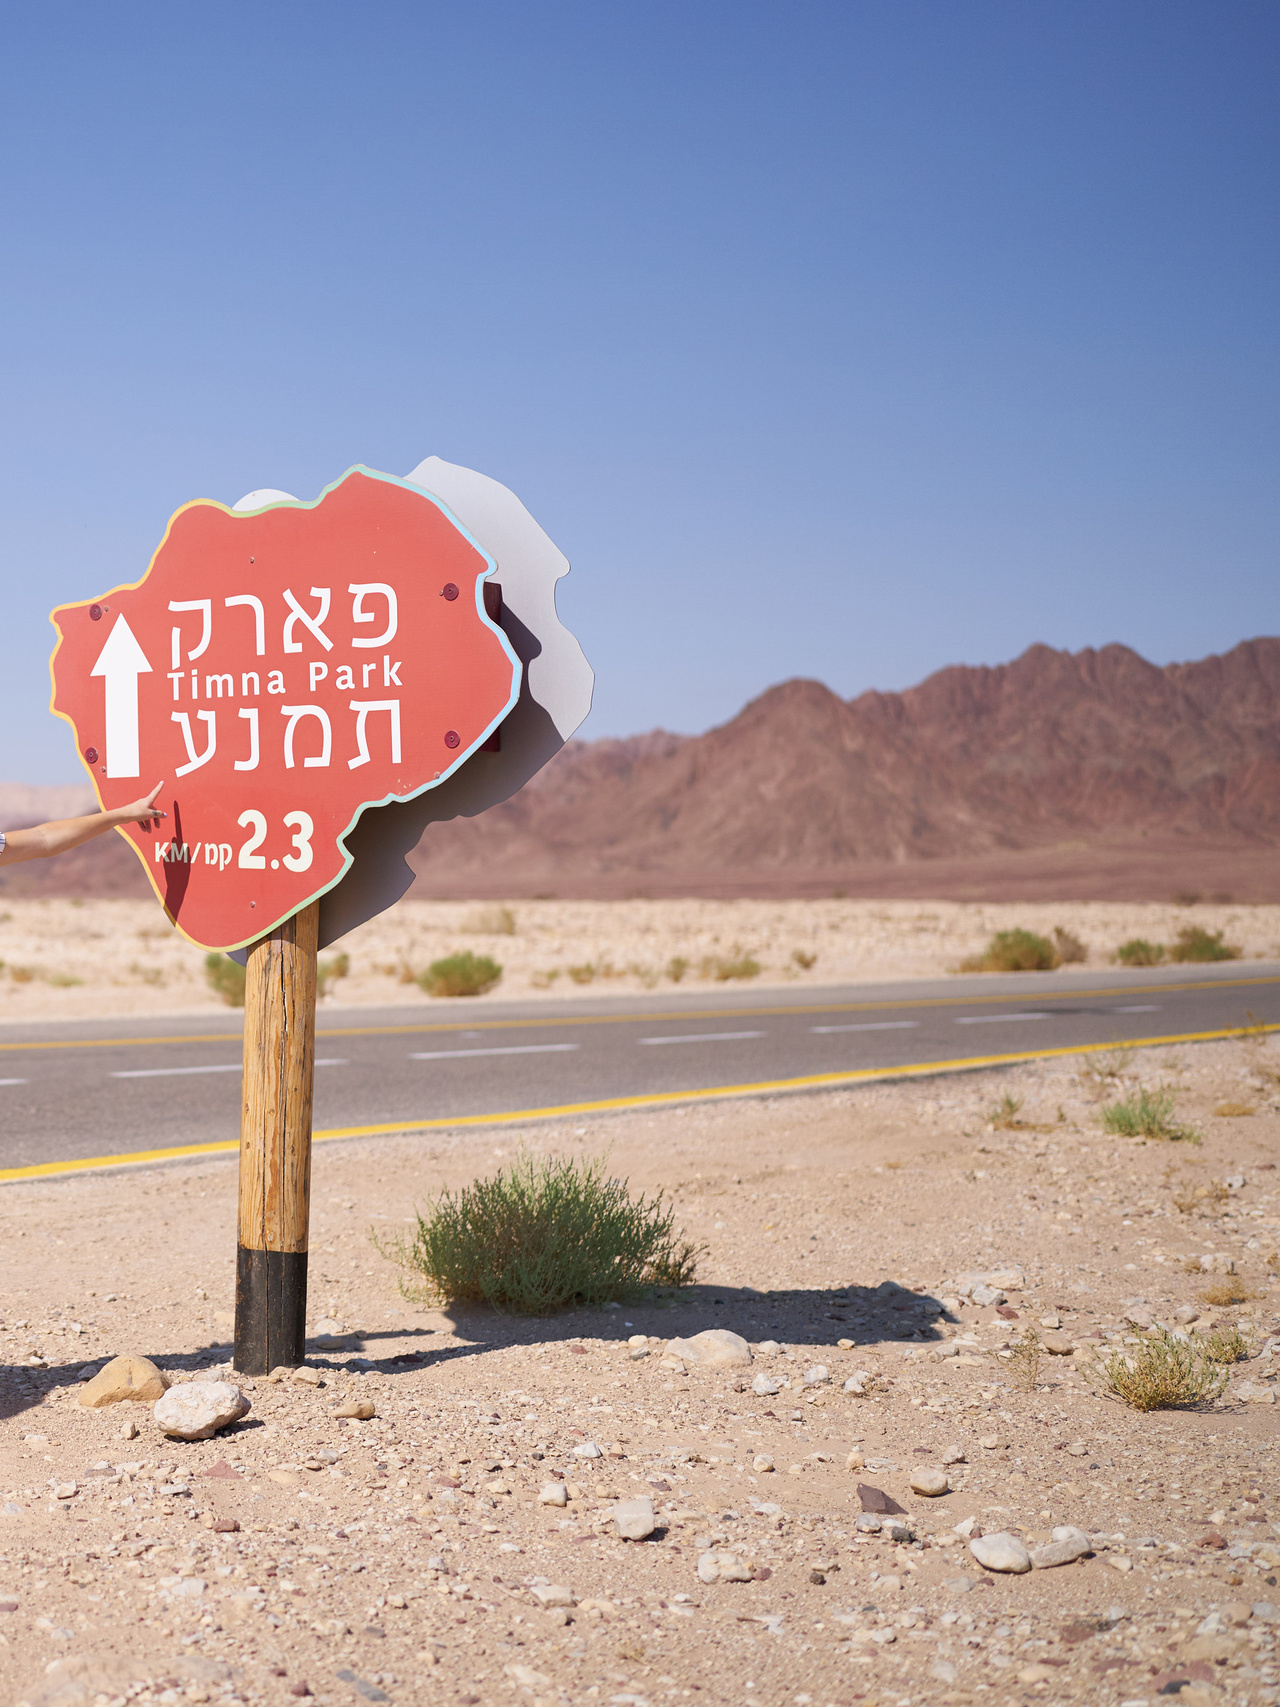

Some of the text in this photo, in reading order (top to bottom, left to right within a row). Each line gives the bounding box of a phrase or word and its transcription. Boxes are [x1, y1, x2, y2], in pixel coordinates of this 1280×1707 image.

[167, 582, 399, 671] פארק
[166, 654, 404, 701] Timna Park
[170, 698, 403, 779] תמנע
[236, 808, 315, 873] 2.3
